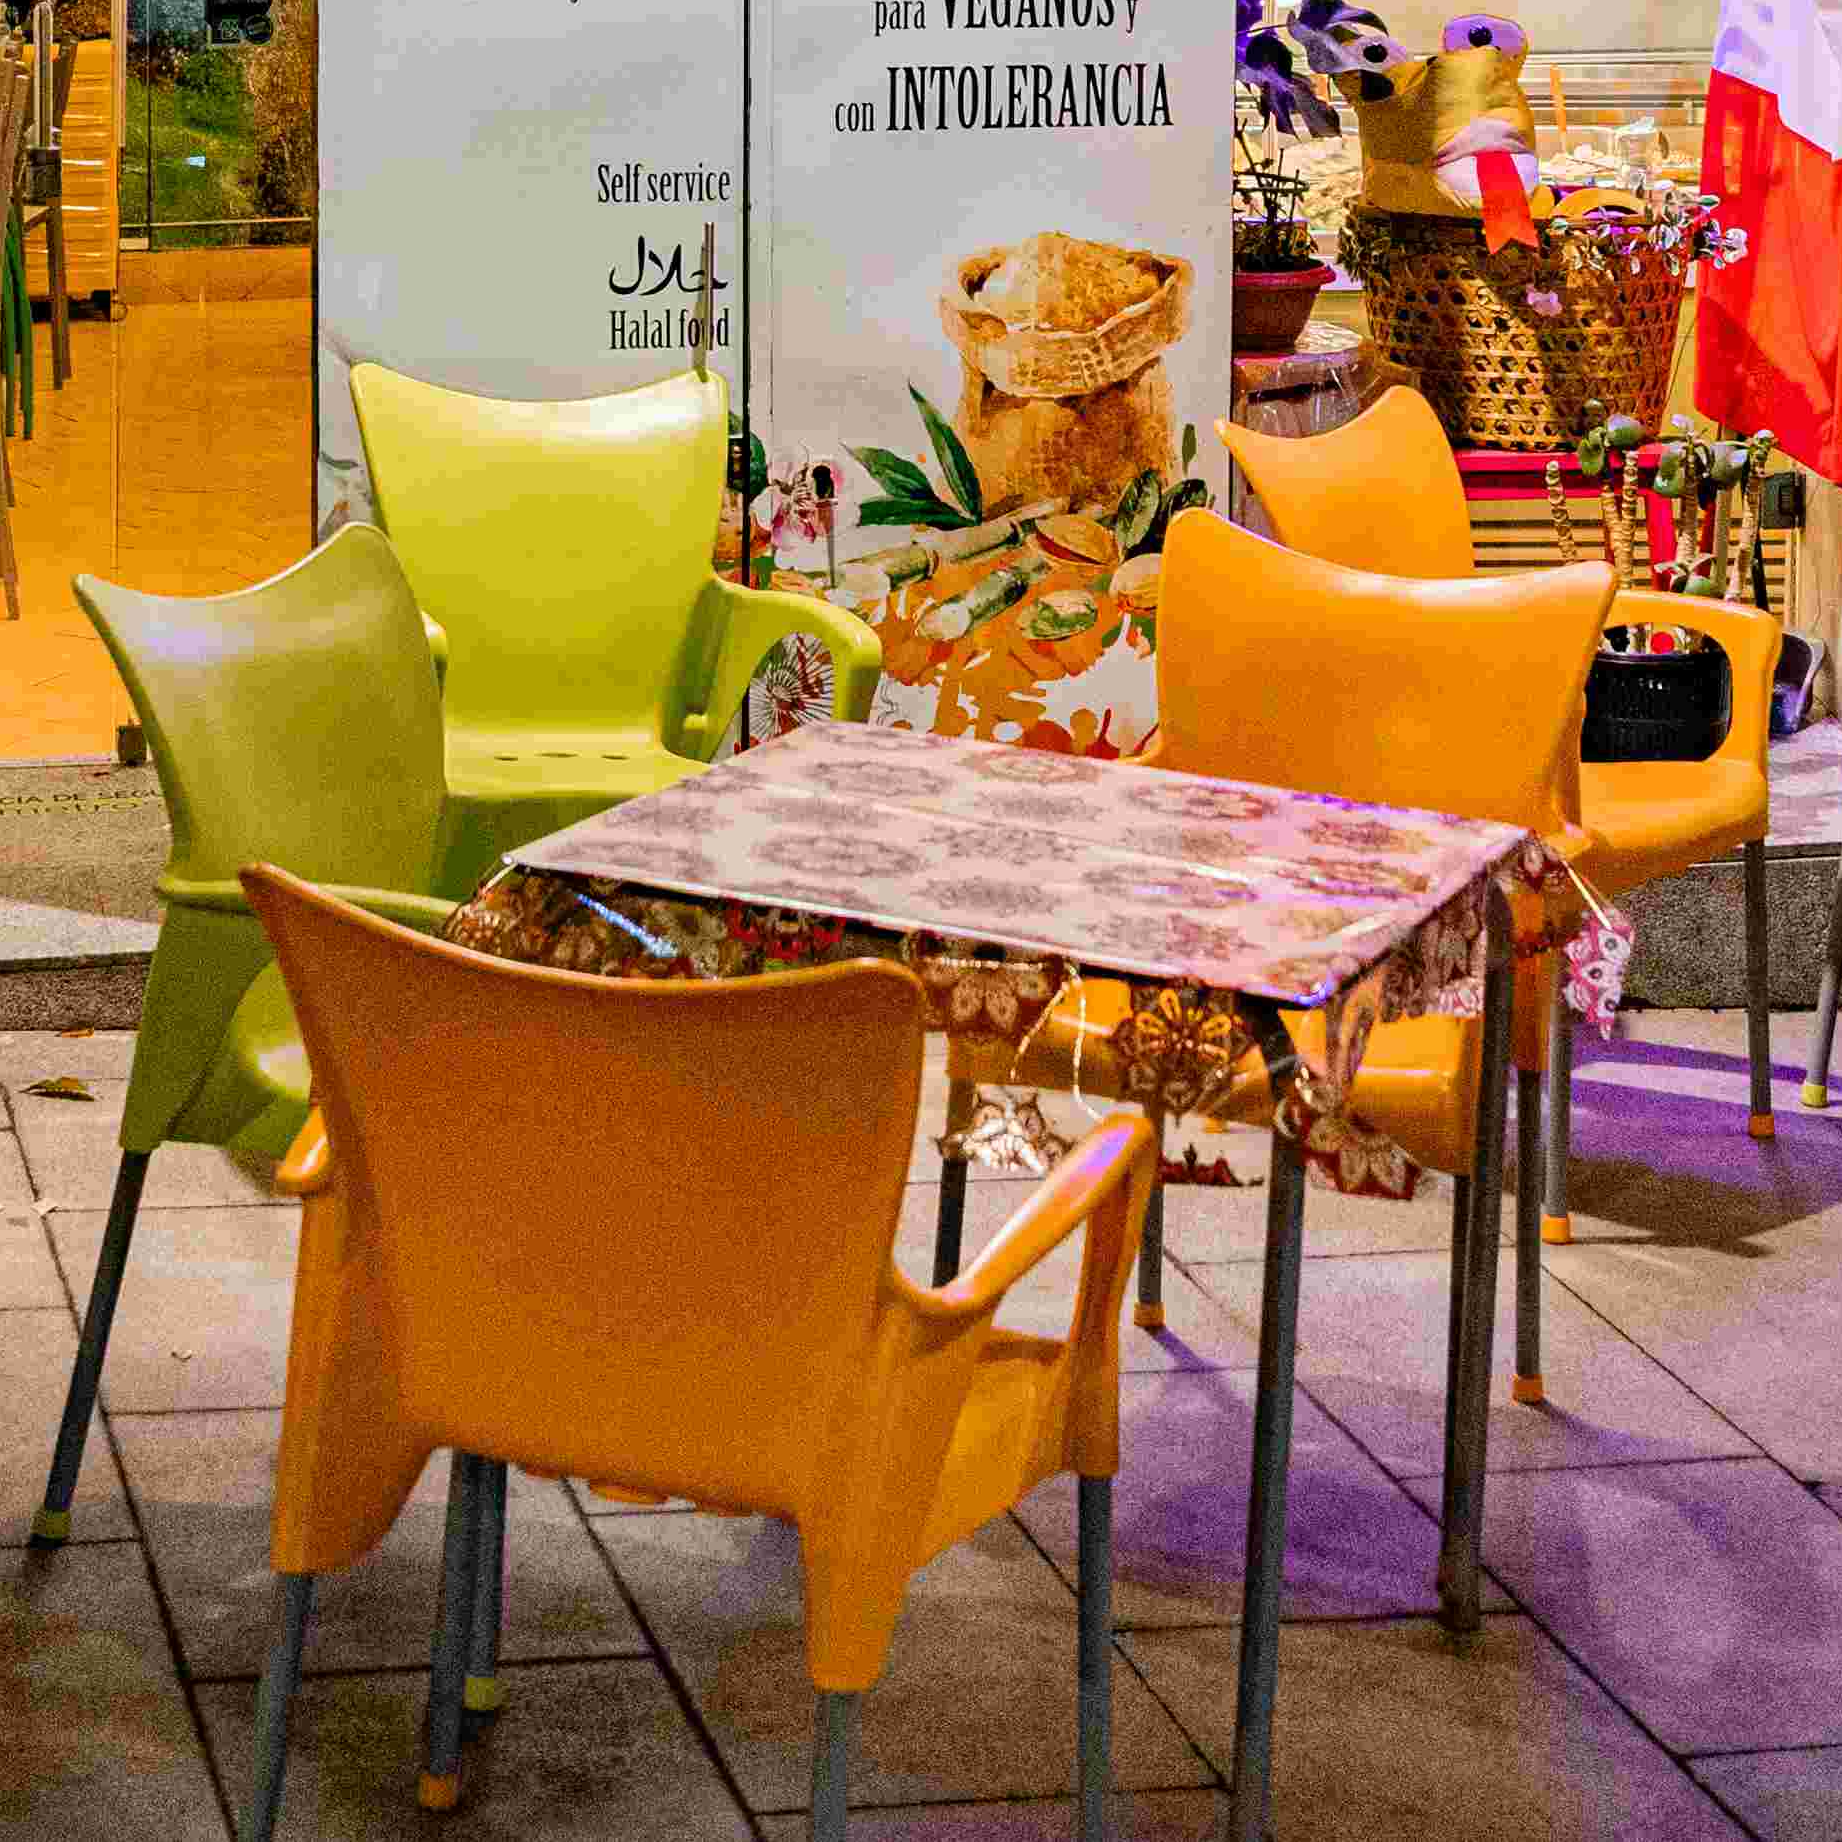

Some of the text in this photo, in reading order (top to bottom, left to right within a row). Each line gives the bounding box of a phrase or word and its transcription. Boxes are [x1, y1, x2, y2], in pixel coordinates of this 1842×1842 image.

[834, 63, 1173, 133] con INTOLERANCIA
[597, 163, 730, 203] Self service
[610, 309, 671, 350] Halal
